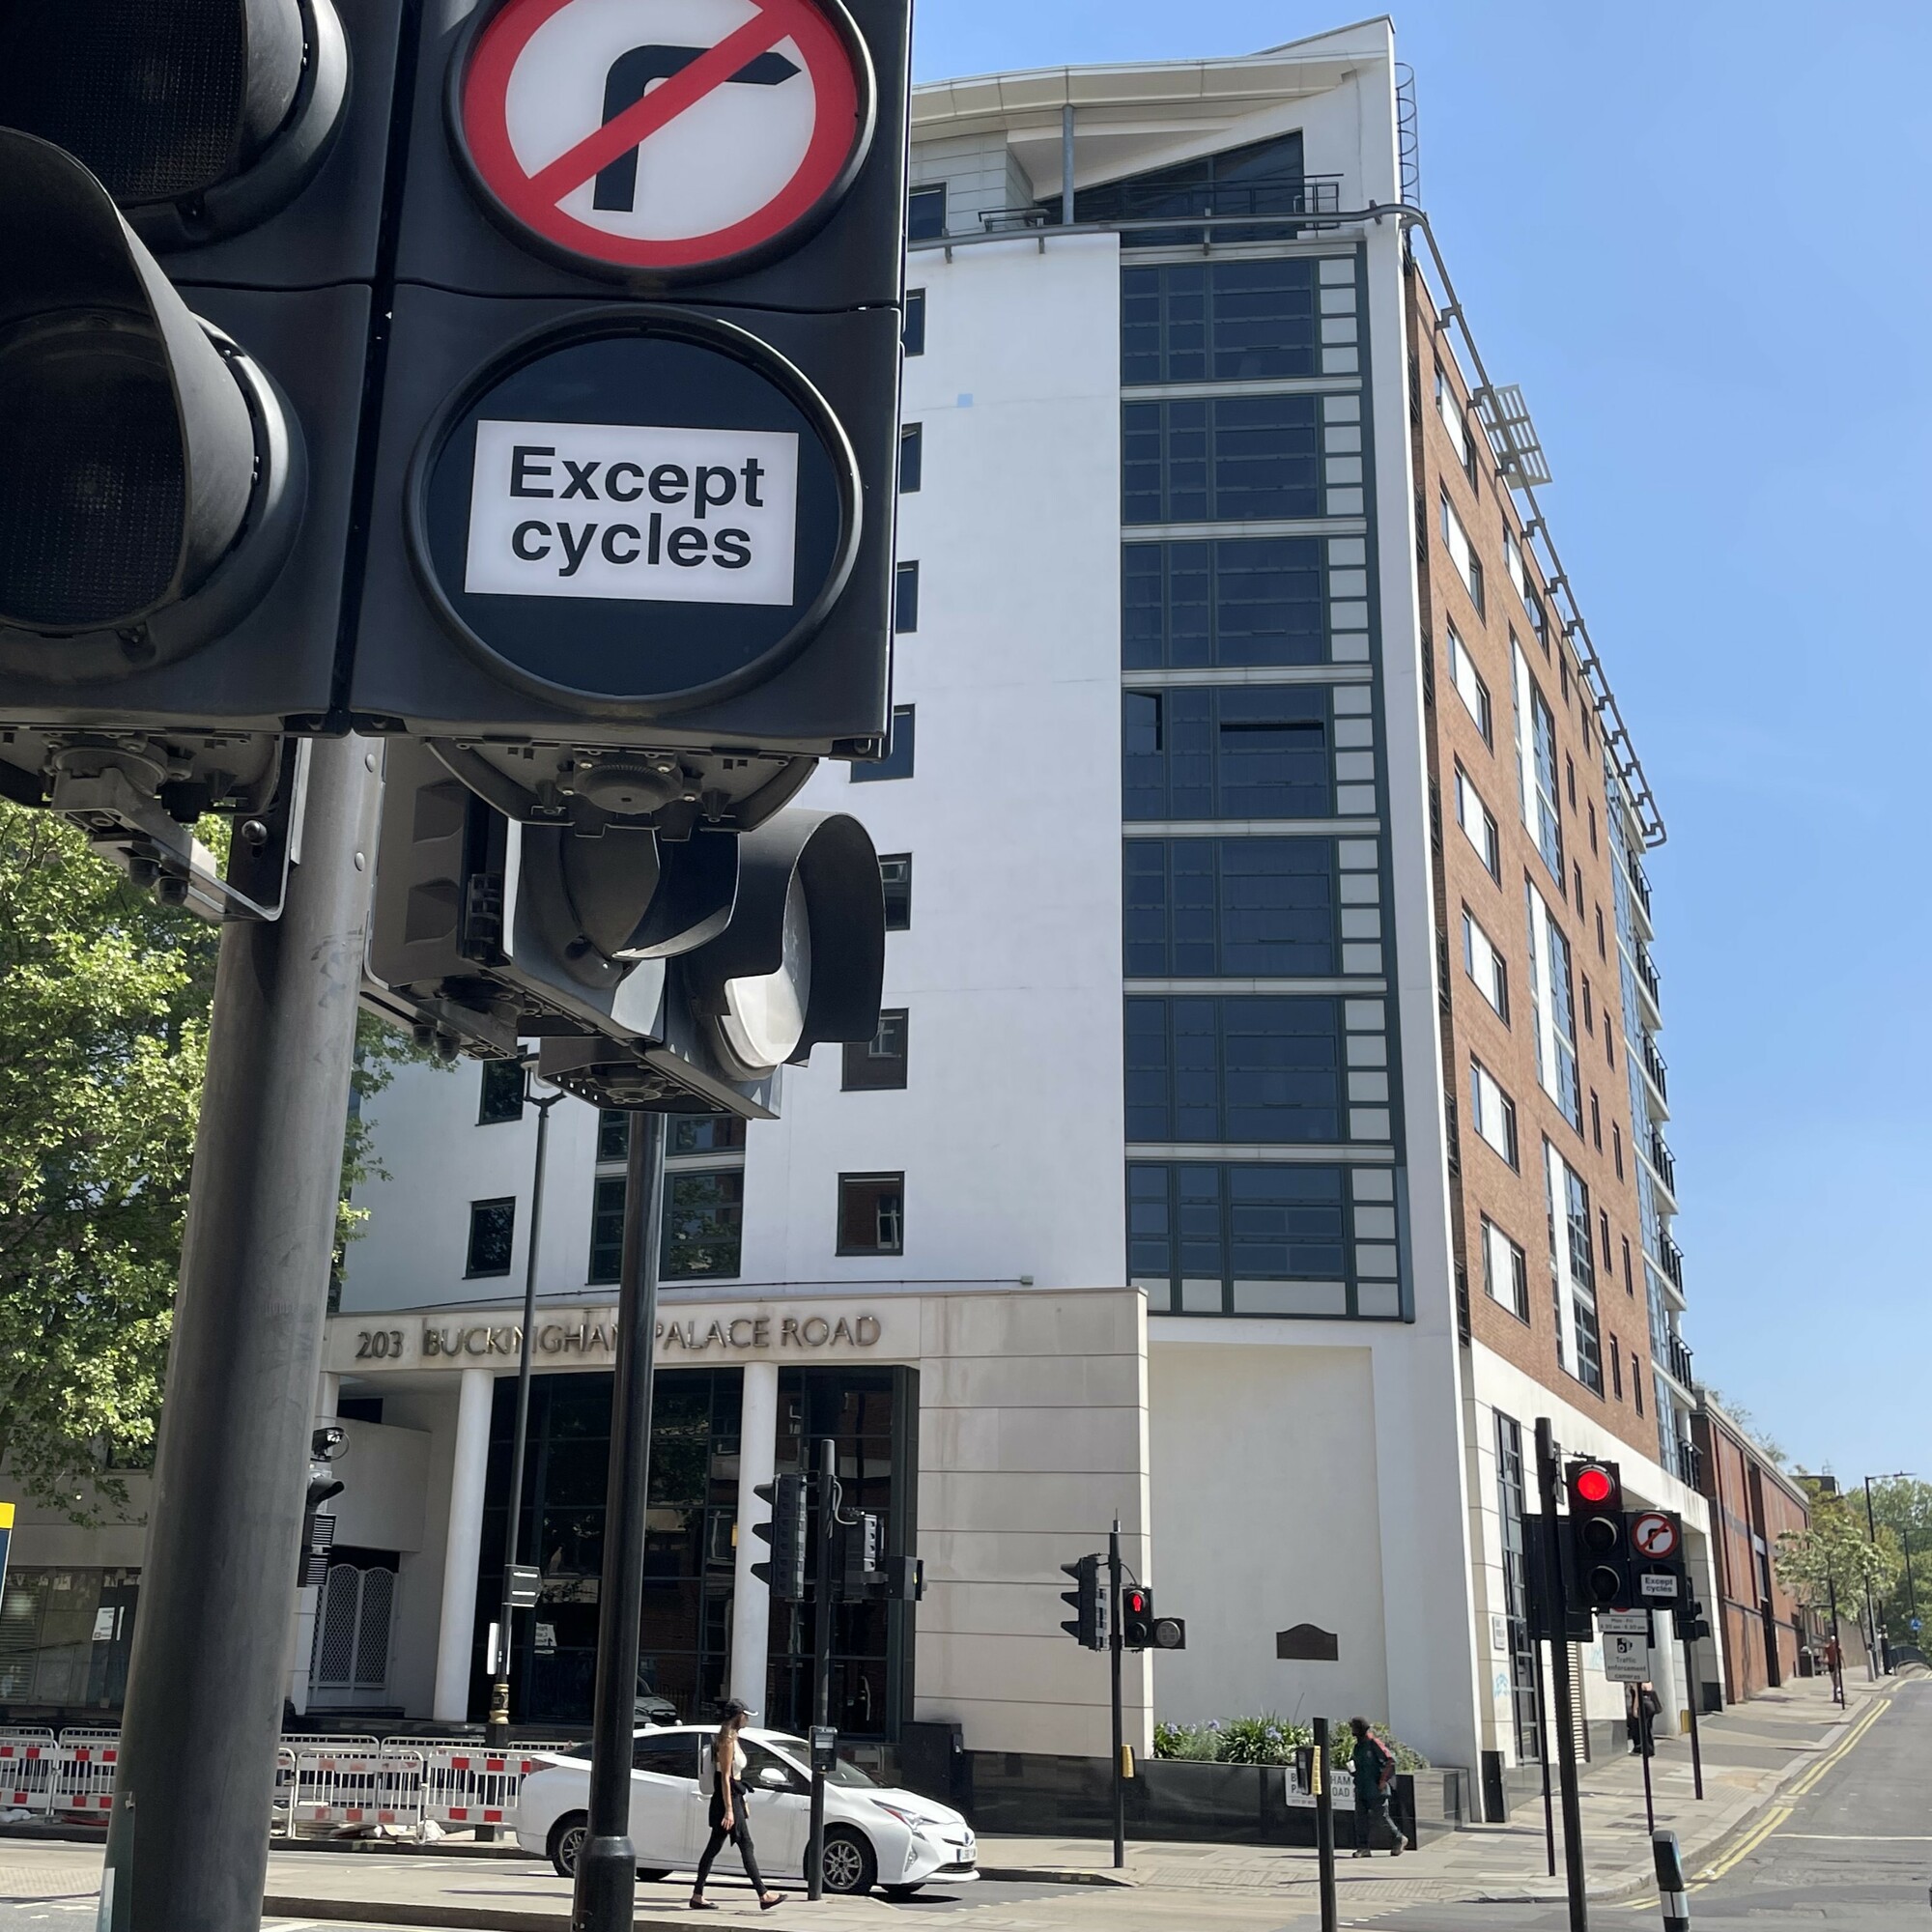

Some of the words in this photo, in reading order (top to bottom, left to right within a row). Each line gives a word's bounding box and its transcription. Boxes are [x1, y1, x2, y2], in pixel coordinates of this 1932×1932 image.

[510, 445, 764, 519] Except
[512, 513, 752, 577] cycles
[355, 1330, 405, 1358] 203
[781, 1316, 881, 1348] ROAD
[1645, 1577, 1673, 1585] Except
[1646, 1584, 1673, 1593] cycles
[1332, 1786, 1350, 1797] OAD
